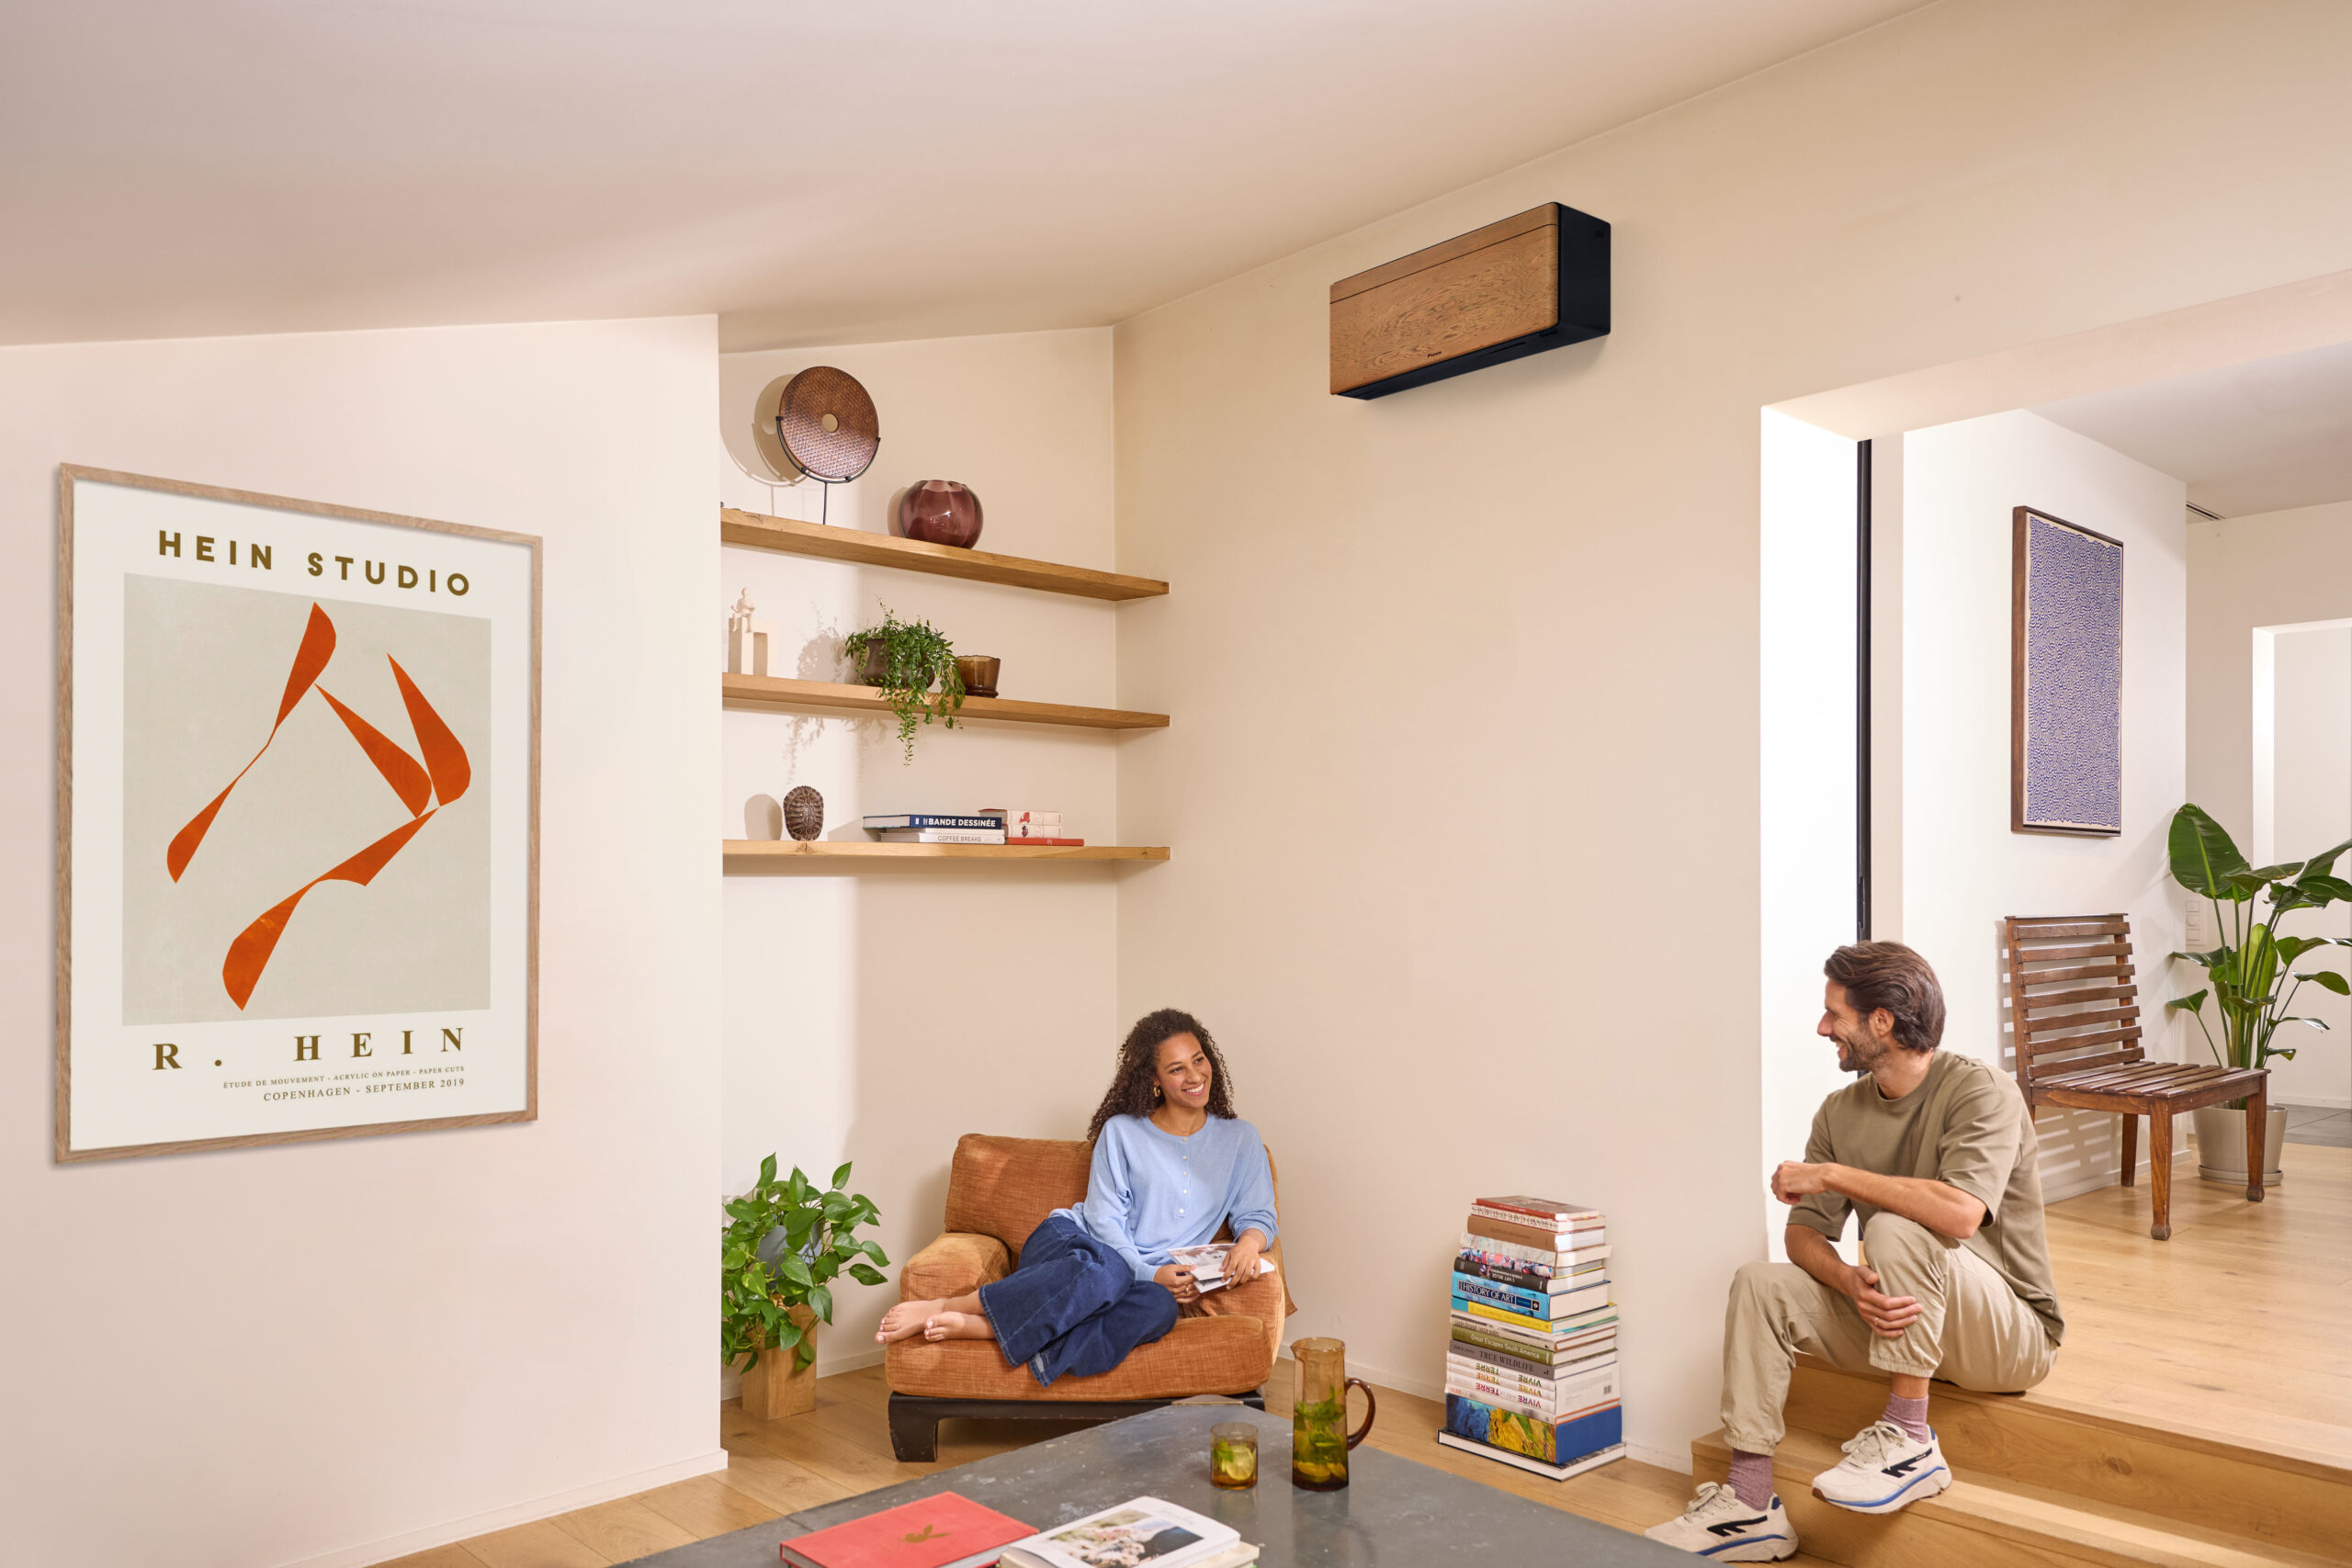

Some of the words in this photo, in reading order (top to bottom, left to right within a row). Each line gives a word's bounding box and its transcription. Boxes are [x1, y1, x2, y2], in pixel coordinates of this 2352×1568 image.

[159, 529, 272, 570] HEIN
[307, 552, 469, 596] STUDIO
[928, 818, 956, 826] BANDE
[958, 818, 995, 827] DESSINÉE
[294, 1027, 464, 1062] HEIN
[270, 1076, 325, 1086] MOUVEMENT
[334, 1073, 369, 1081] ACRYLIC
[263, 1087, 351, 1101] COPENHAGEN
[366, 1080, 435, 1094] SEPTEMBER
[440, 1078, 465, 1088] 2019
[1463, 1283, 1489, 1297] HISTORY
[1490, 1290, 1500, 1300] OF
[1500, 1291, 1515, 1303] ART
[1470, 1334, 1483, 1343] Great
[1484, 1337, 1504, 1349] Escapes
[1504, 1343, 1519, 1353] South
[1519, 1348, 1539, 1359] America
[1479, 1350, 1498, 1361] TRUE
[1499, 1354, 1534, 1372] WILDLIFE
[1476, 1363, 1499, 1376] TERRE
[1476, 1372, 1500, 1385] TERRE
[1518, 1375, 1541, 1387] VIVRE
[1476, 1383, 1500, 1396] TERRE
[1518, 1384, 1542, 1398] VIVRE
[1518, 1395, 1541, 1409] VIVRE
